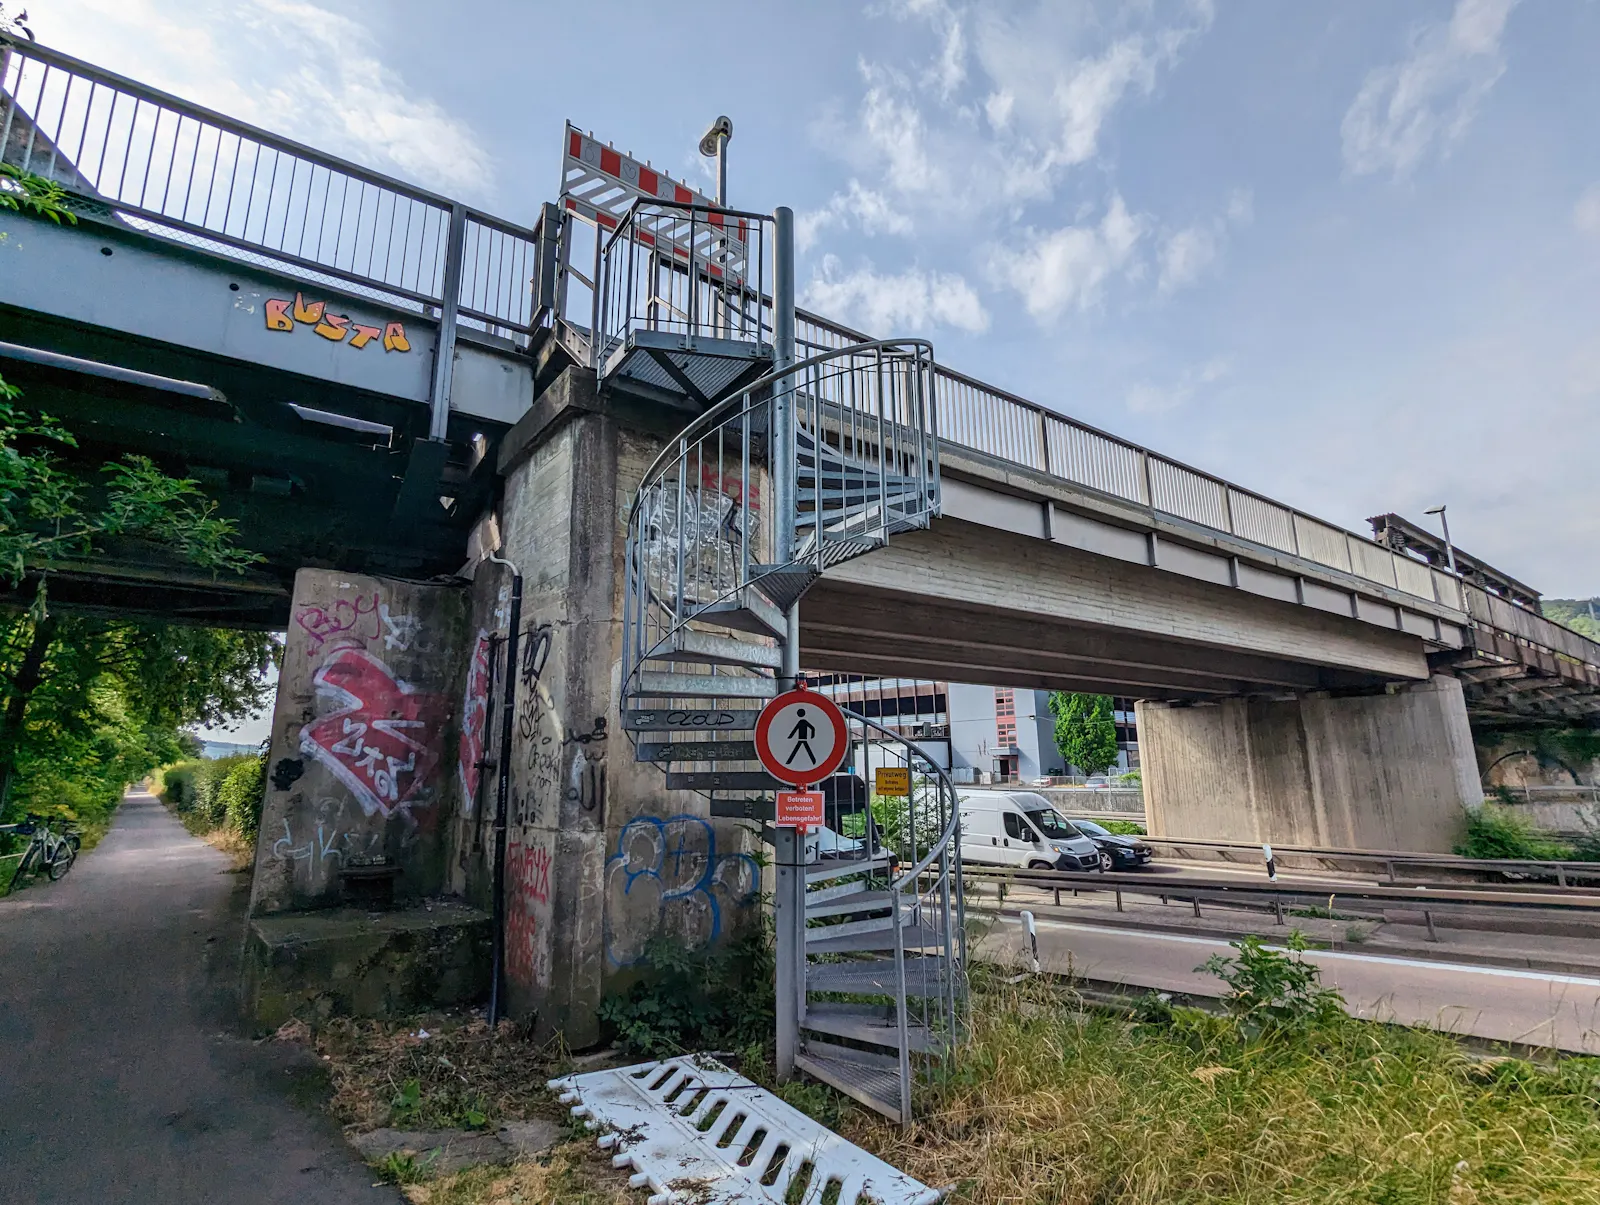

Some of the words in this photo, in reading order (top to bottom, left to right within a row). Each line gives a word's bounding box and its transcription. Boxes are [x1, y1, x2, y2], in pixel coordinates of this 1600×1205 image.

[264, 291, 412, 353] BUSTA
[877, 770, 907, 780] Privatweg
[778, 815, 822, 823] Lebensgefahr!
